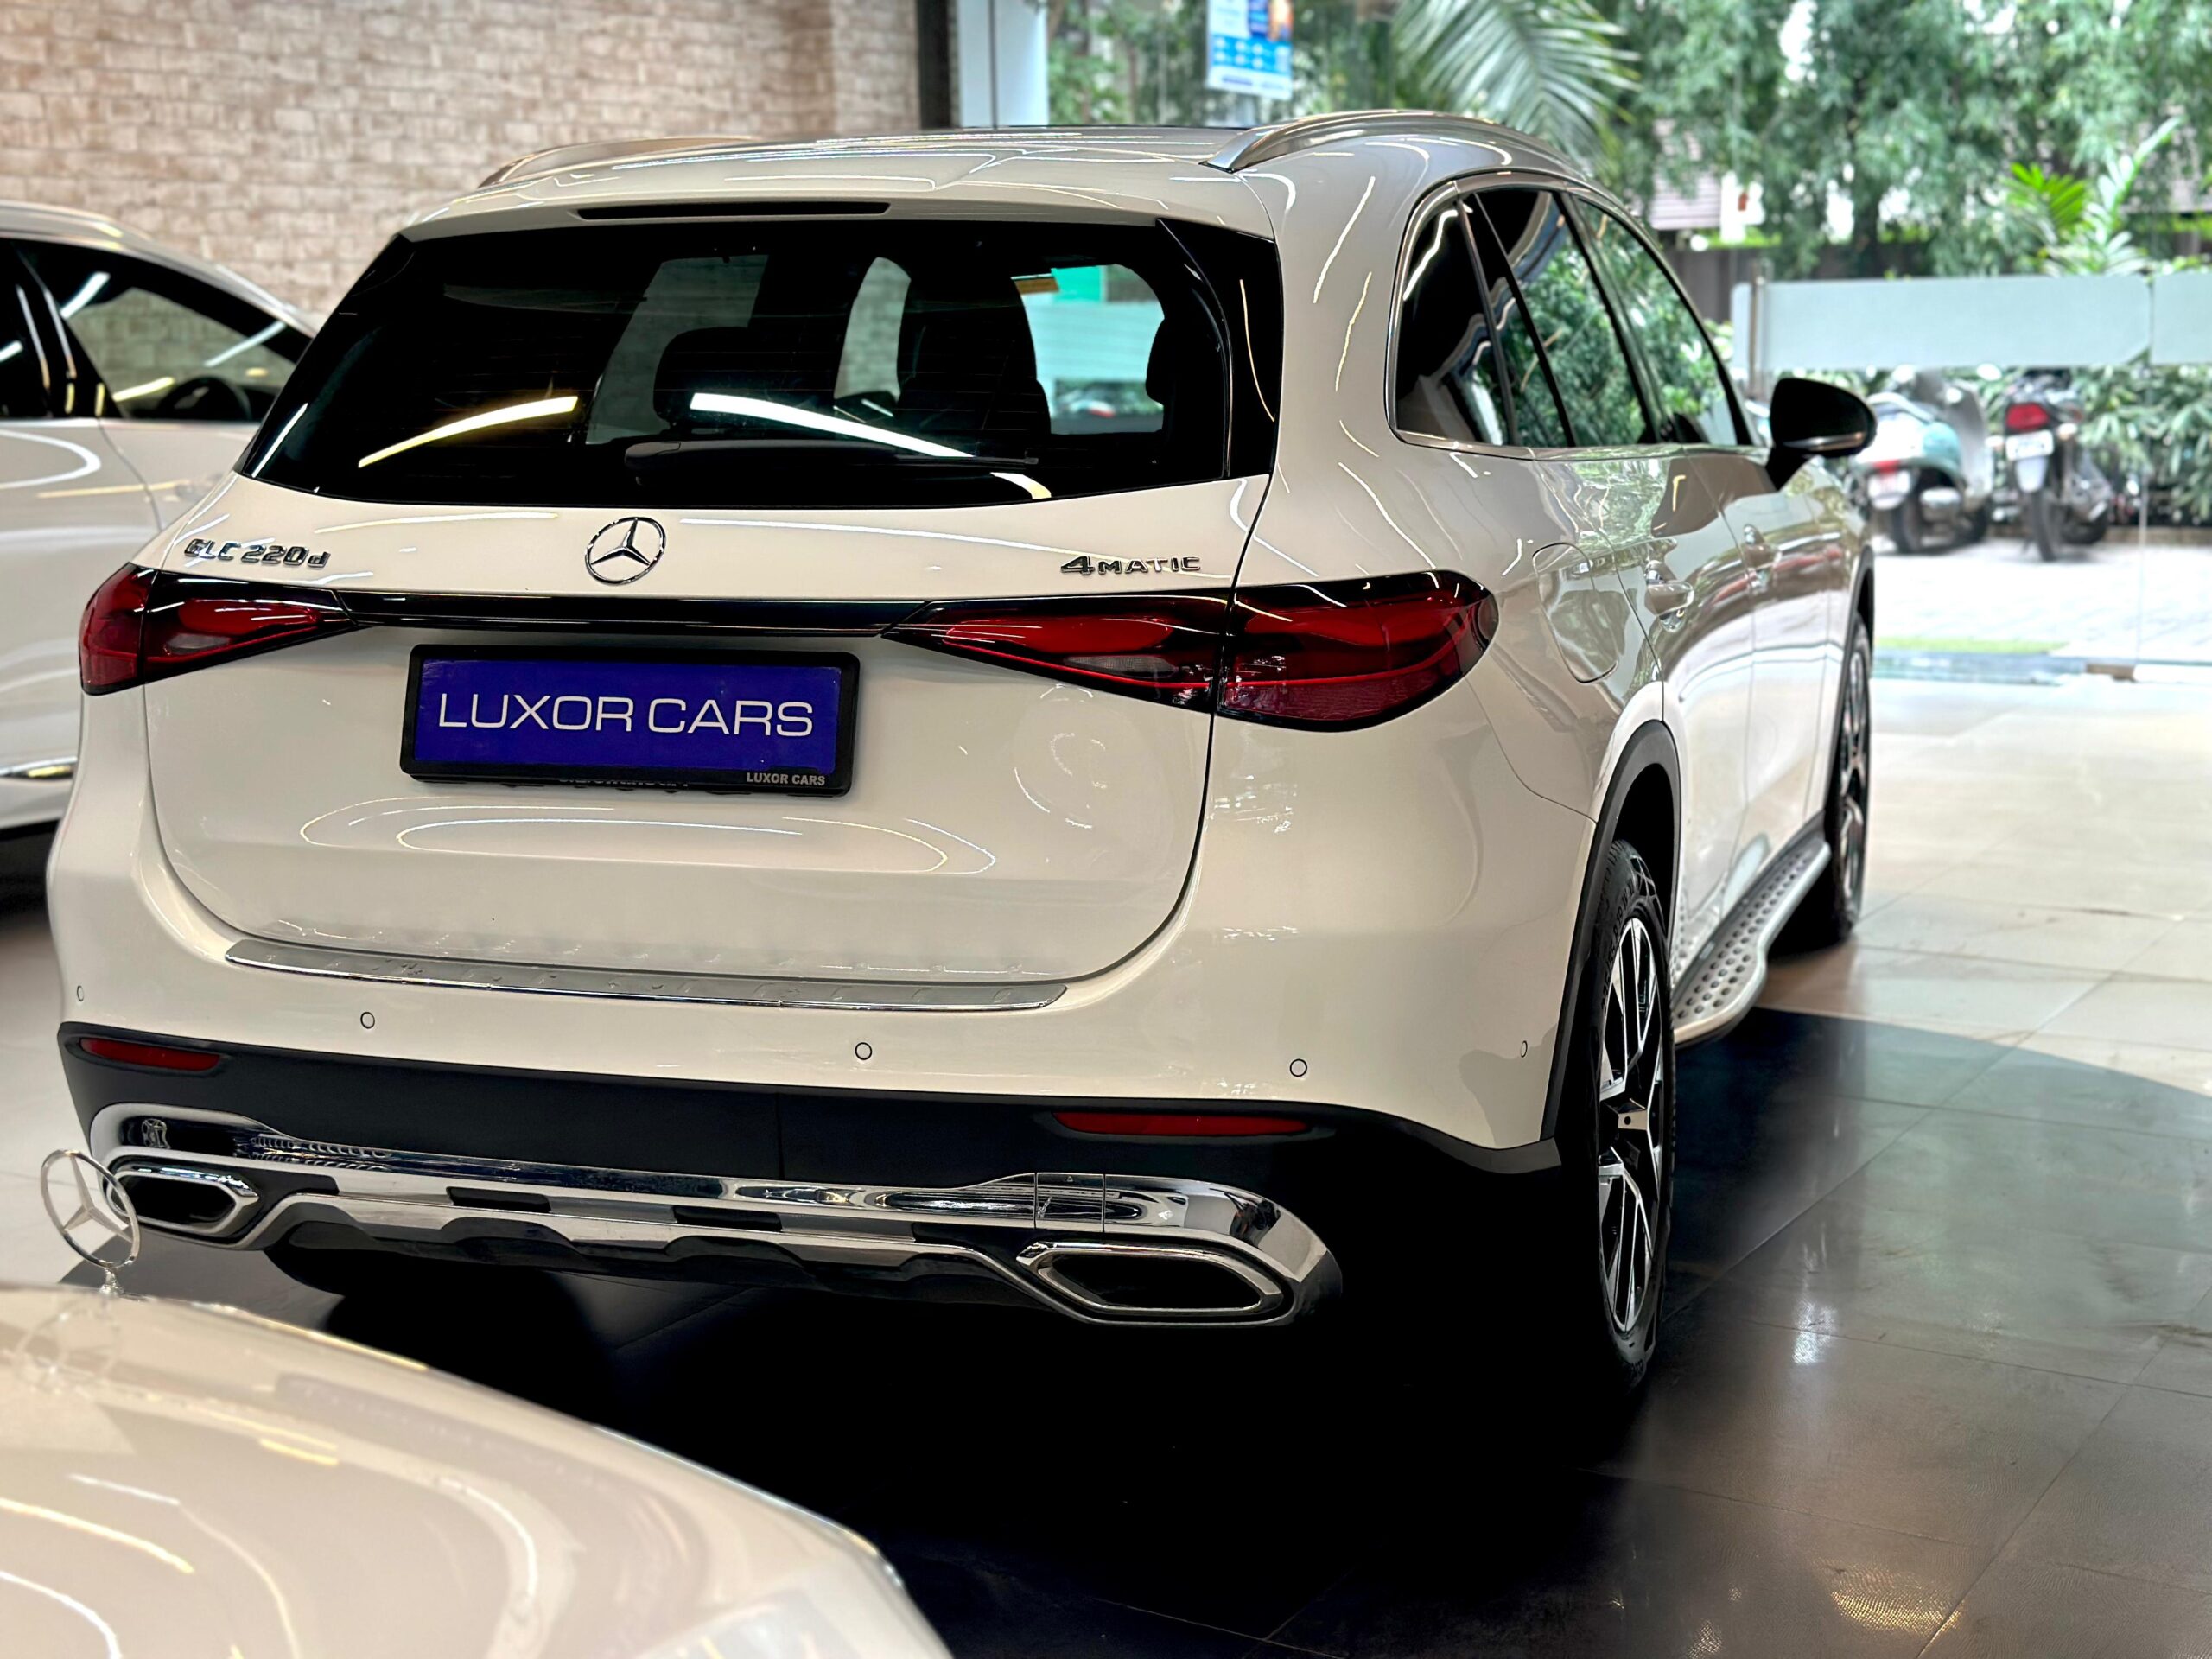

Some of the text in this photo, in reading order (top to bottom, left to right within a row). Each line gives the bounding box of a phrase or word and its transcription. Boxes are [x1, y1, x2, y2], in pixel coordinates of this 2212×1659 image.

[183, 537, 332, 568] GLC 220d
[1060, 556, 1201, 575] 4MATIC
[438, 692, 814, 738] LUXOR CARS
[746, 772, 826, 786] LUXOR CARS
